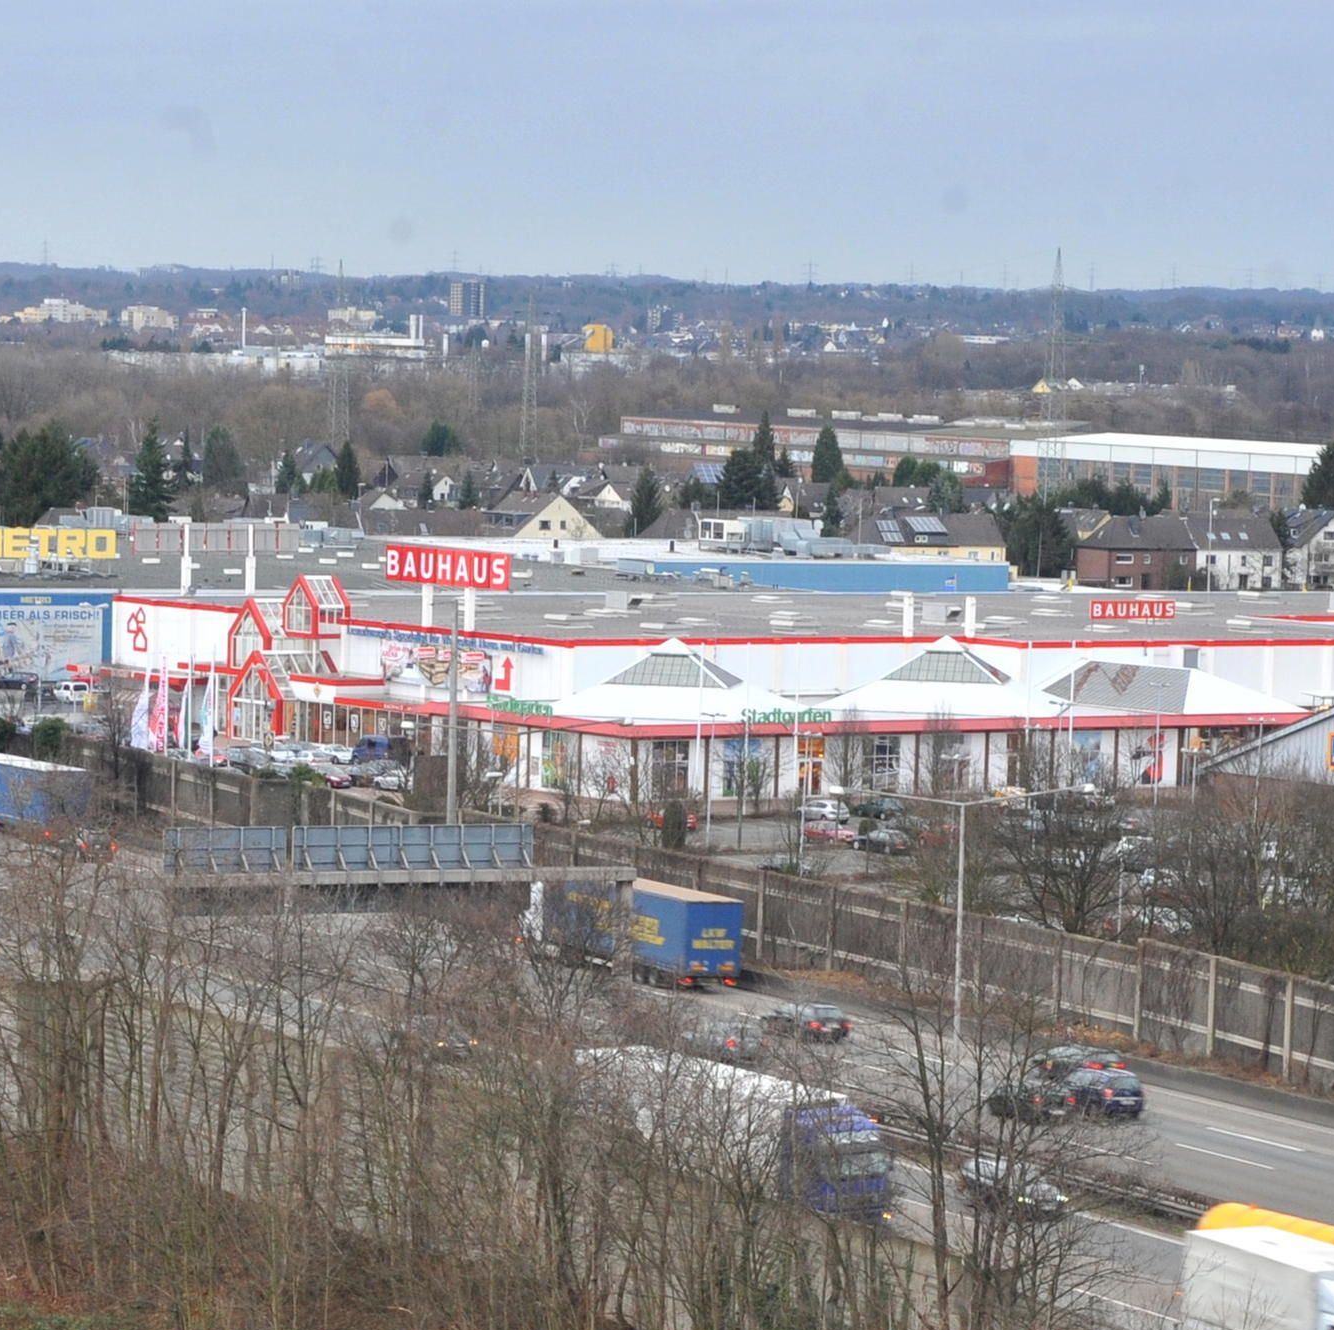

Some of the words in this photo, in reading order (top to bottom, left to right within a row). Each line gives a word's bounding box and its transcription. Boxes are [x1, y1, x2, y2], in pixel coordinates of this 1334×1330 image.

[387, 549, 506, 585] BAUHAUS
[28, 610, 50, 620] ALS
[54, 609, 100, 620] FRISCH!
[1093, 603, 1174, 617] BAUHAUS
[701, 928, 727, 938] LKW
[692, 939, 735, 950] WALTER
